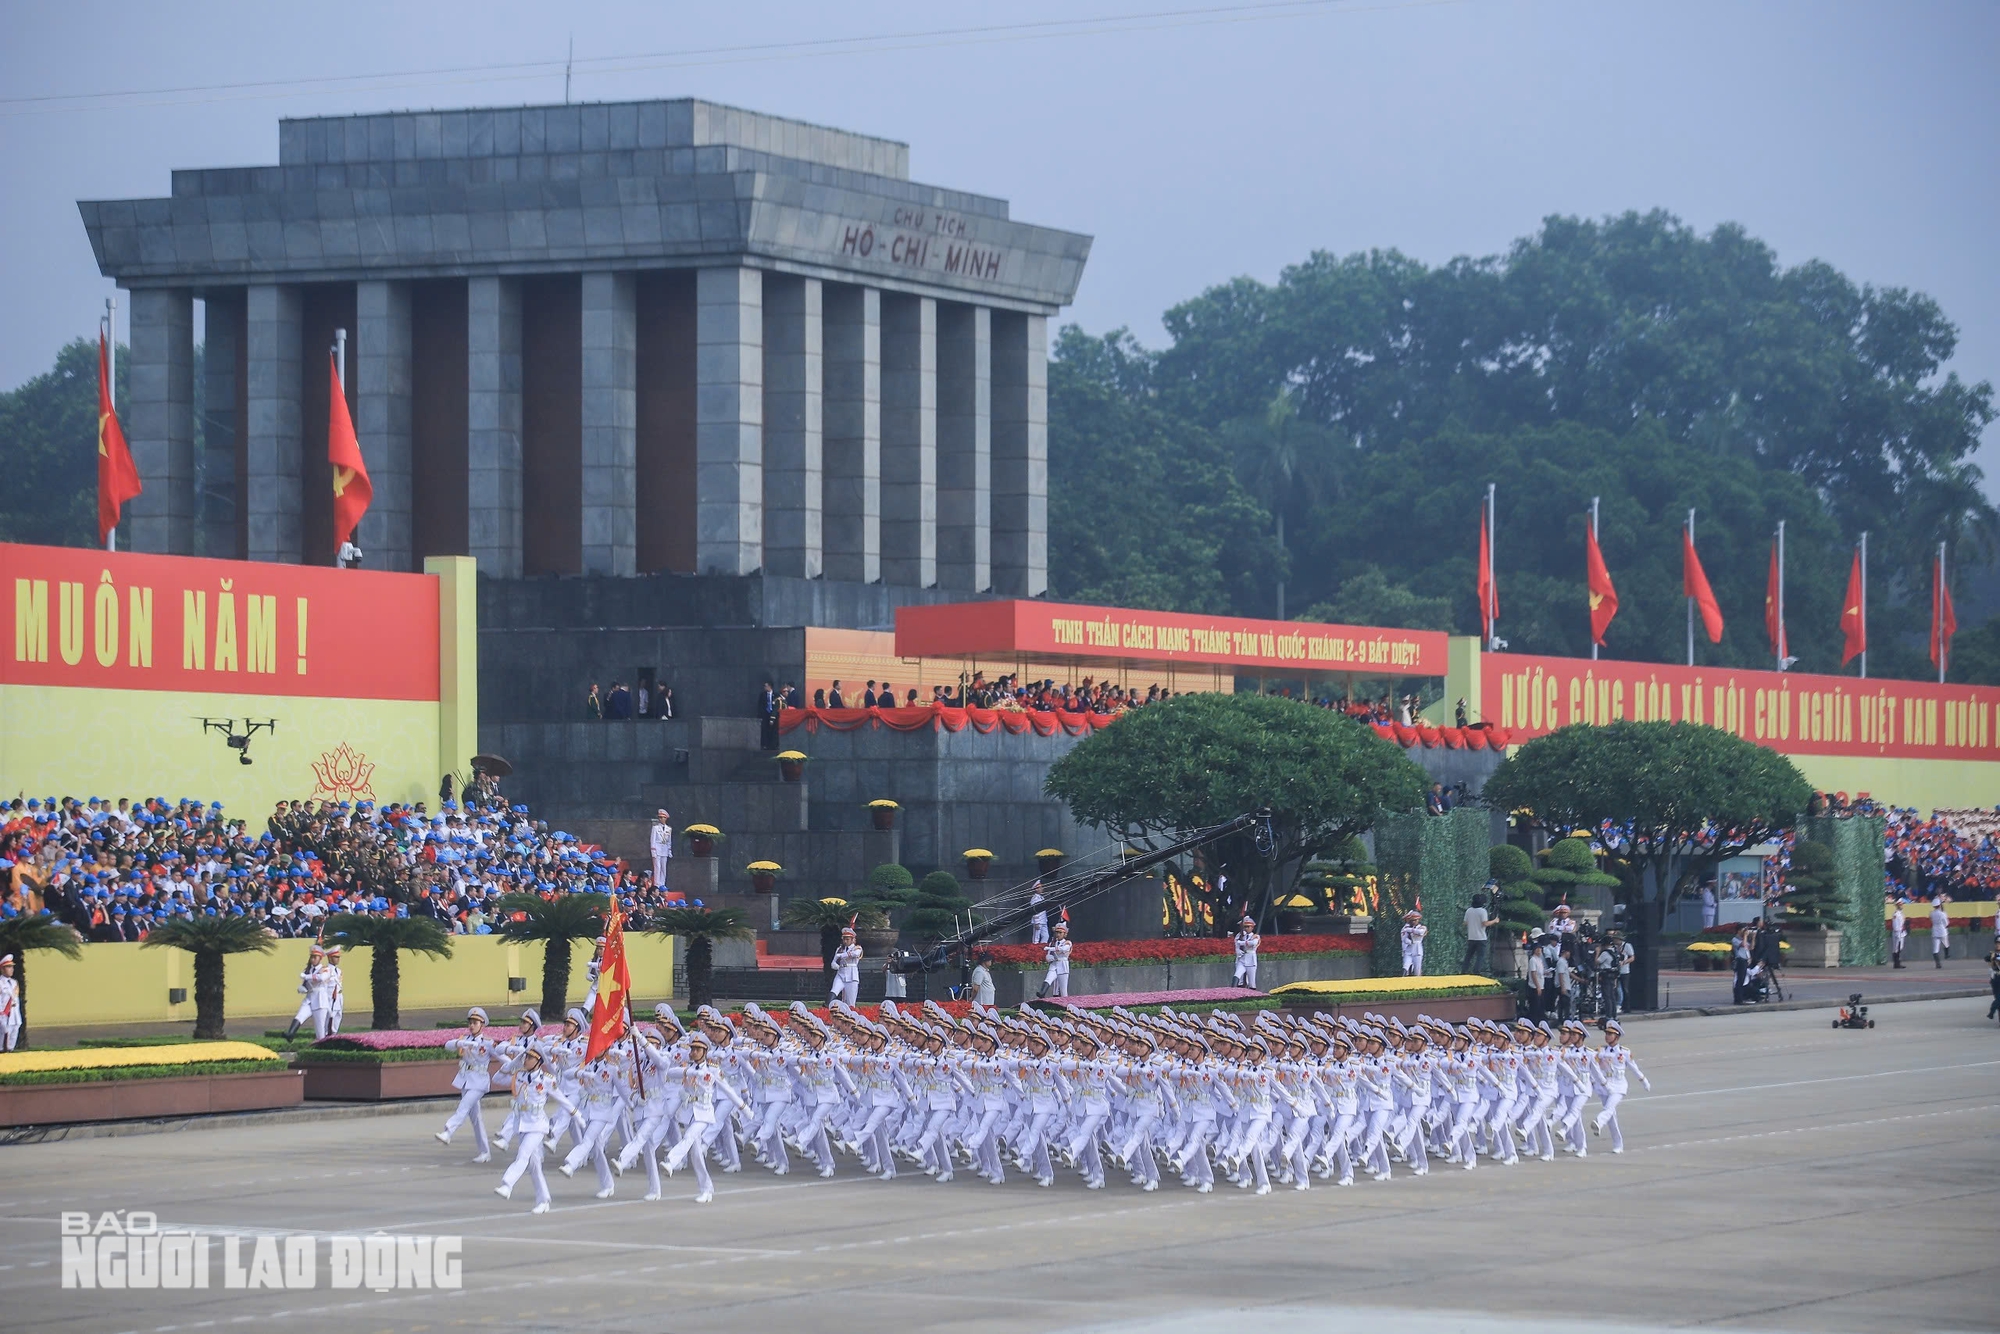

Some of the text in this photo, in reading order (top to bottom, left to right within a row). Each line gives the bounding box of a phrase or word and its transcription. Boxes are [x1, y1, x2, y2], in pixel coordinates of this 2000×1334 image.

[15, 569, 153, 668] MUÔN
[183, 577, 277, 674] NĂM
[1052, 618, 1084, 645] TINH
[1086, 614, 1120, 647] THẦN
[1122, 620, 1154, 649] CÁCH
[1157, 626, 1190, 655] MẠNG
[1192, 626, 1231, 655] THÁNG
[1233, 628, 1258, 657] TÁM
[1260, 630, 1275, 658] VÀ
[1278, 629, 1306, 660] QUỐC
[1308, 633, 1344, 661] KHÁNH
[1346, 638, 1366, 664] 2-9
[1368, 634, 1390, 664] BẤT
[1501, 665, 1559, 731] NƯỚC
[1634, 673, 1672, 723] HÒA
[1755, 678, 1791, 741] CHỦ
[1798, 686, 1853, 743] NGHĨA
[1860, 687, 1897, 754] VIỆT
[1903, 697, 1937, 747] NAM
[1945, 693, 1988, 748] MUÔN
